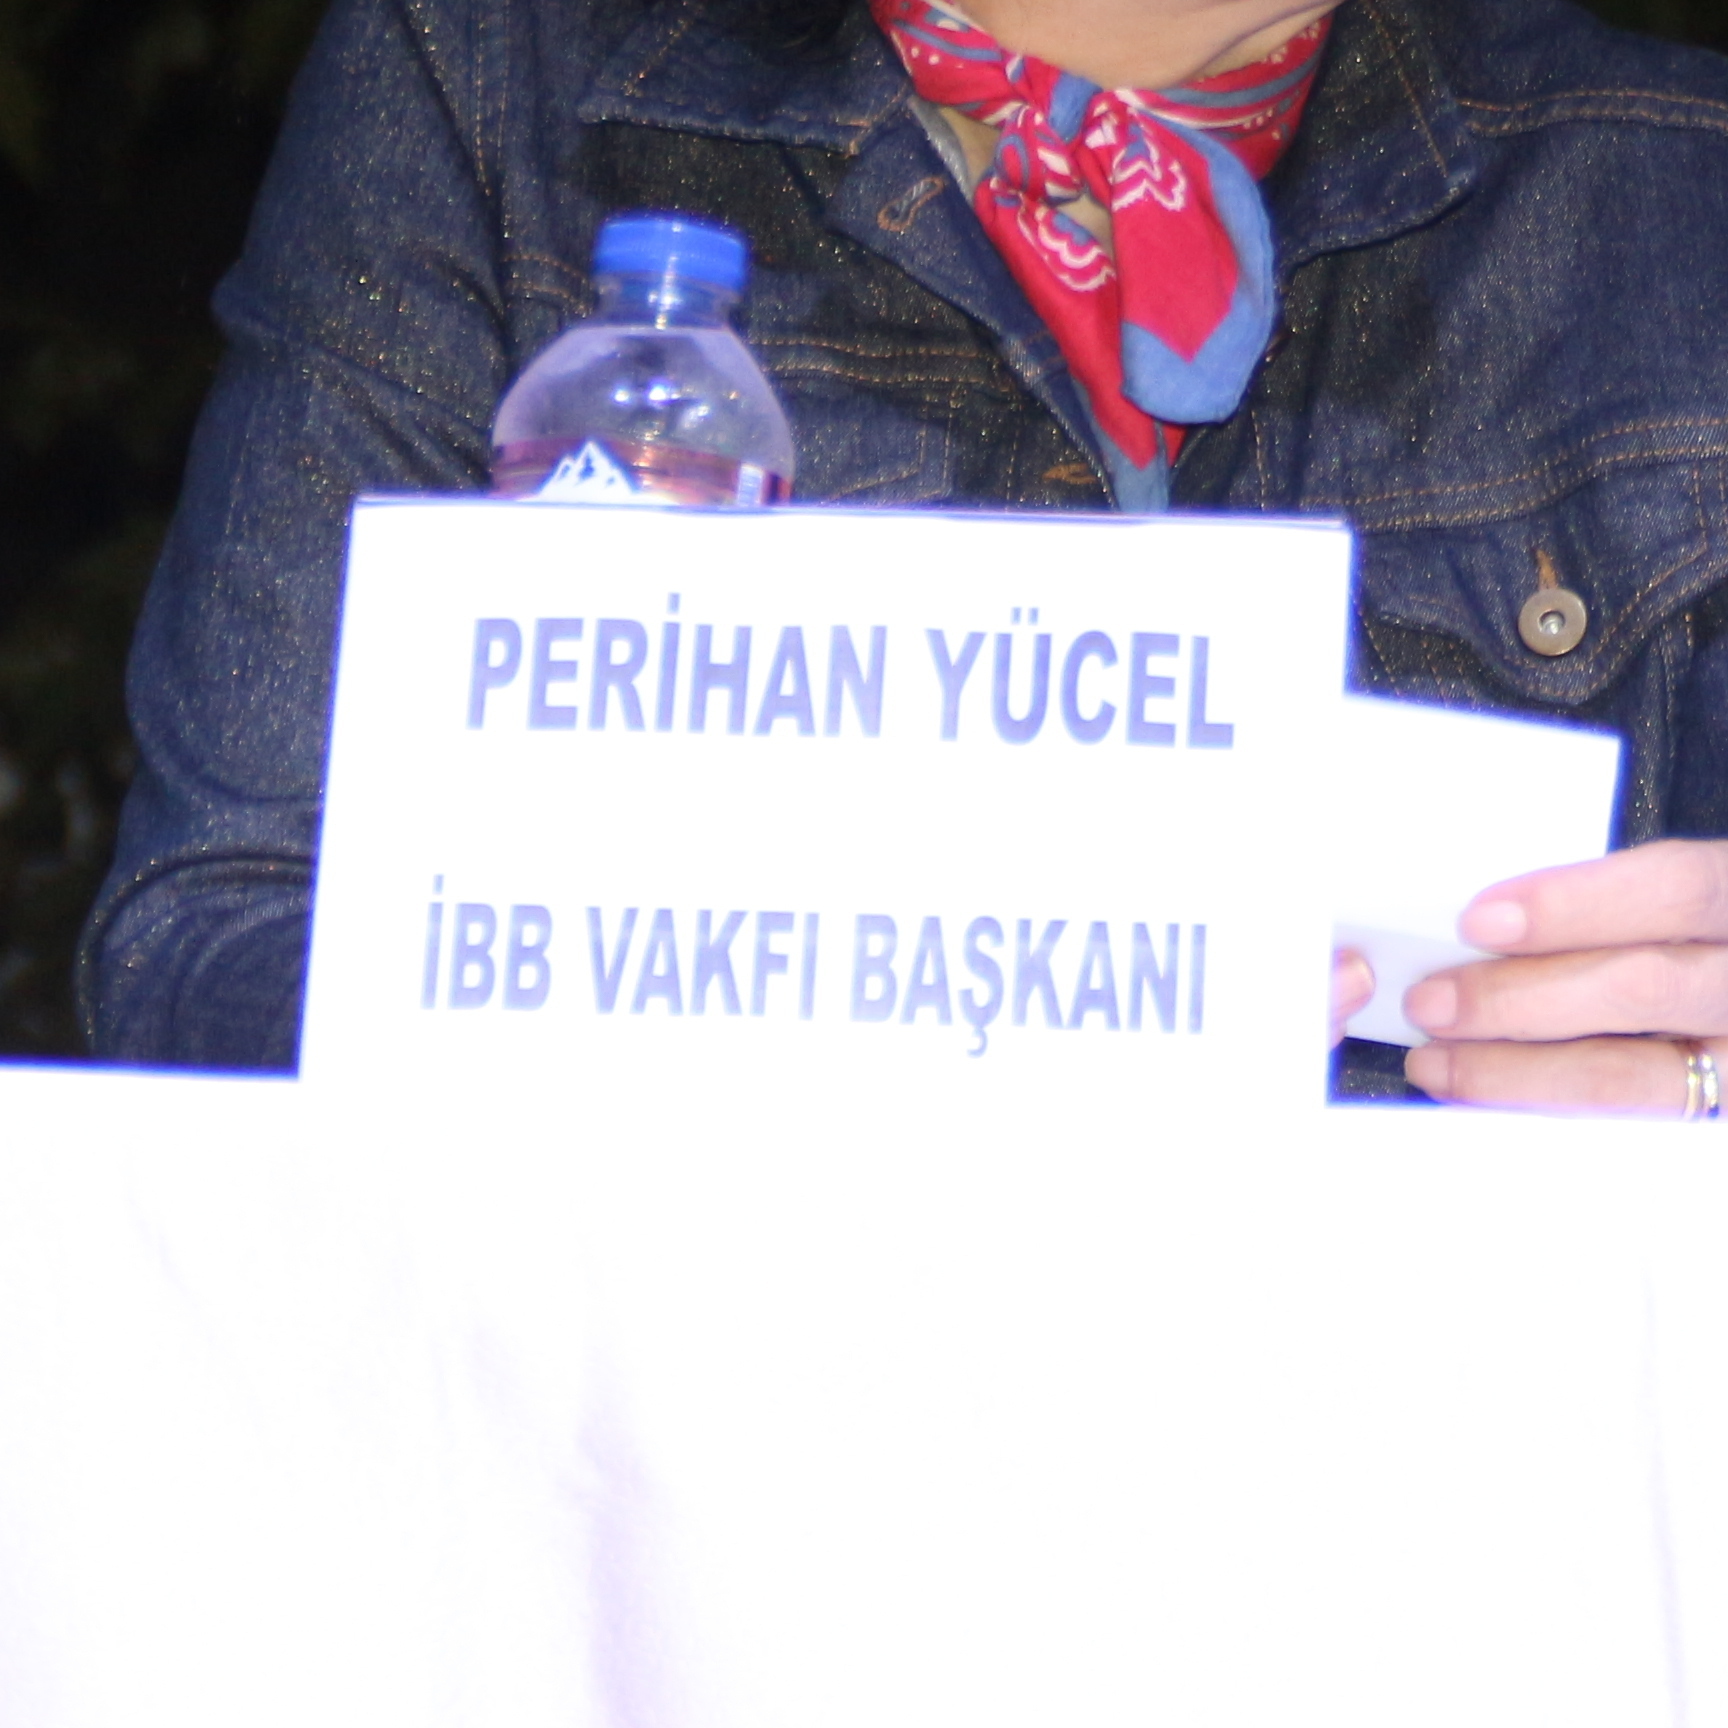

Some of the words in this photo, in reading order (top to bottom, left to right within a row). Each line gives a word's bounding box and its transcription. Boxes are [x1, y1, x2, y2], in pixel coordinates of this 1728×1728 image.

[465, 591, 889, 739] PERİHAN
[924, 605, 1237, 751] YÜCEL
[419, 872, 555, 1013] İBB
[584, 904, 821, 1021] VAKFI
[849, 912, 1208, 1059] BAŞKANI
